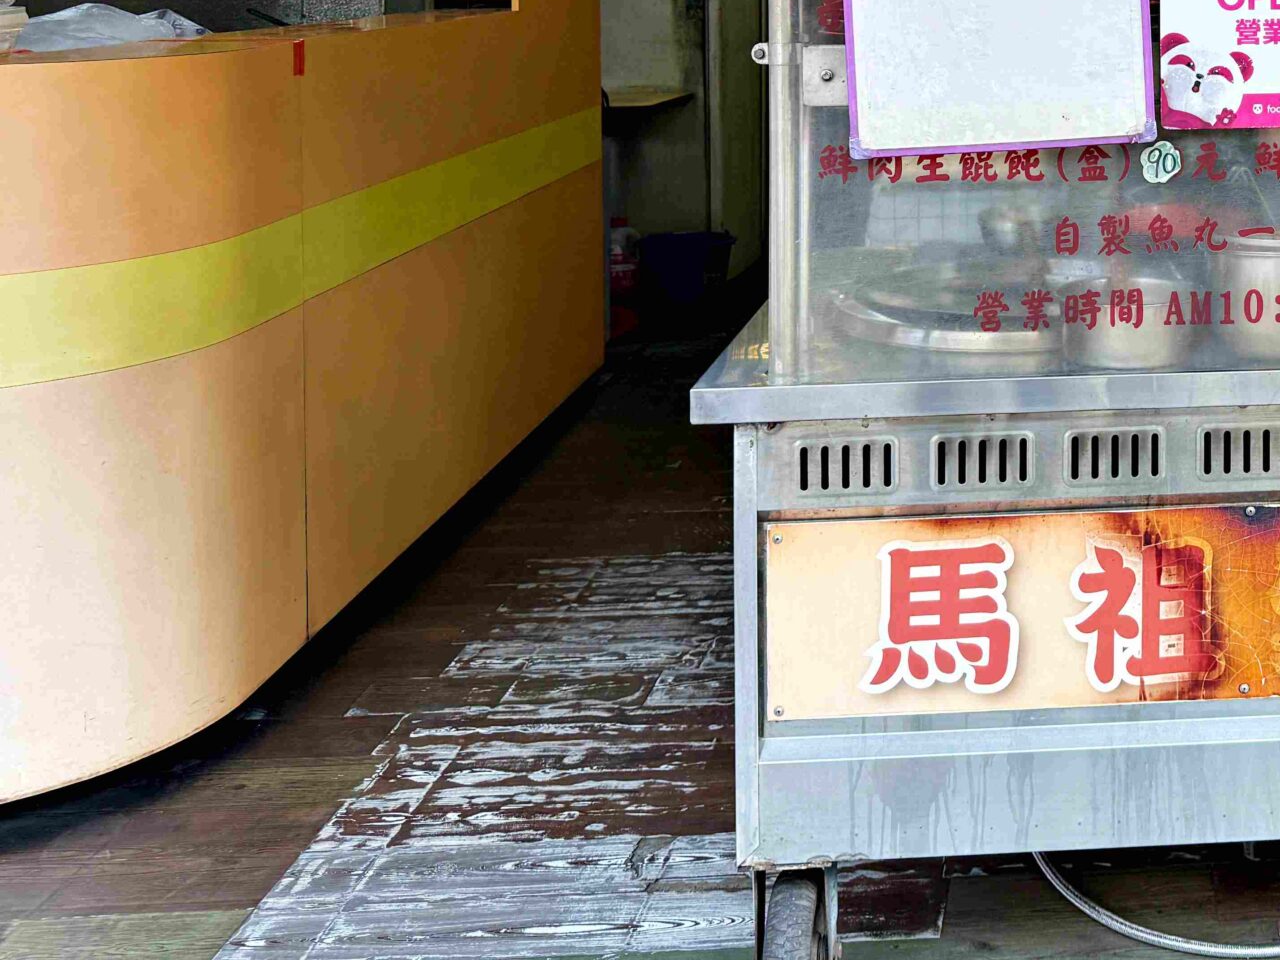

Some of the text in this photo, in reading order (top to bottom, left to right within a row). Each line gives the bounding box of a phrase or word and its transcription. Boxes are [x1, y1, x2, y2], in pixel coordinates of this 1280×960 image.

[1147, 148, 1178, 174] 90
[1192, 142, 1227, 181] 元
[972, 287, 1145, 333] 營業時間
